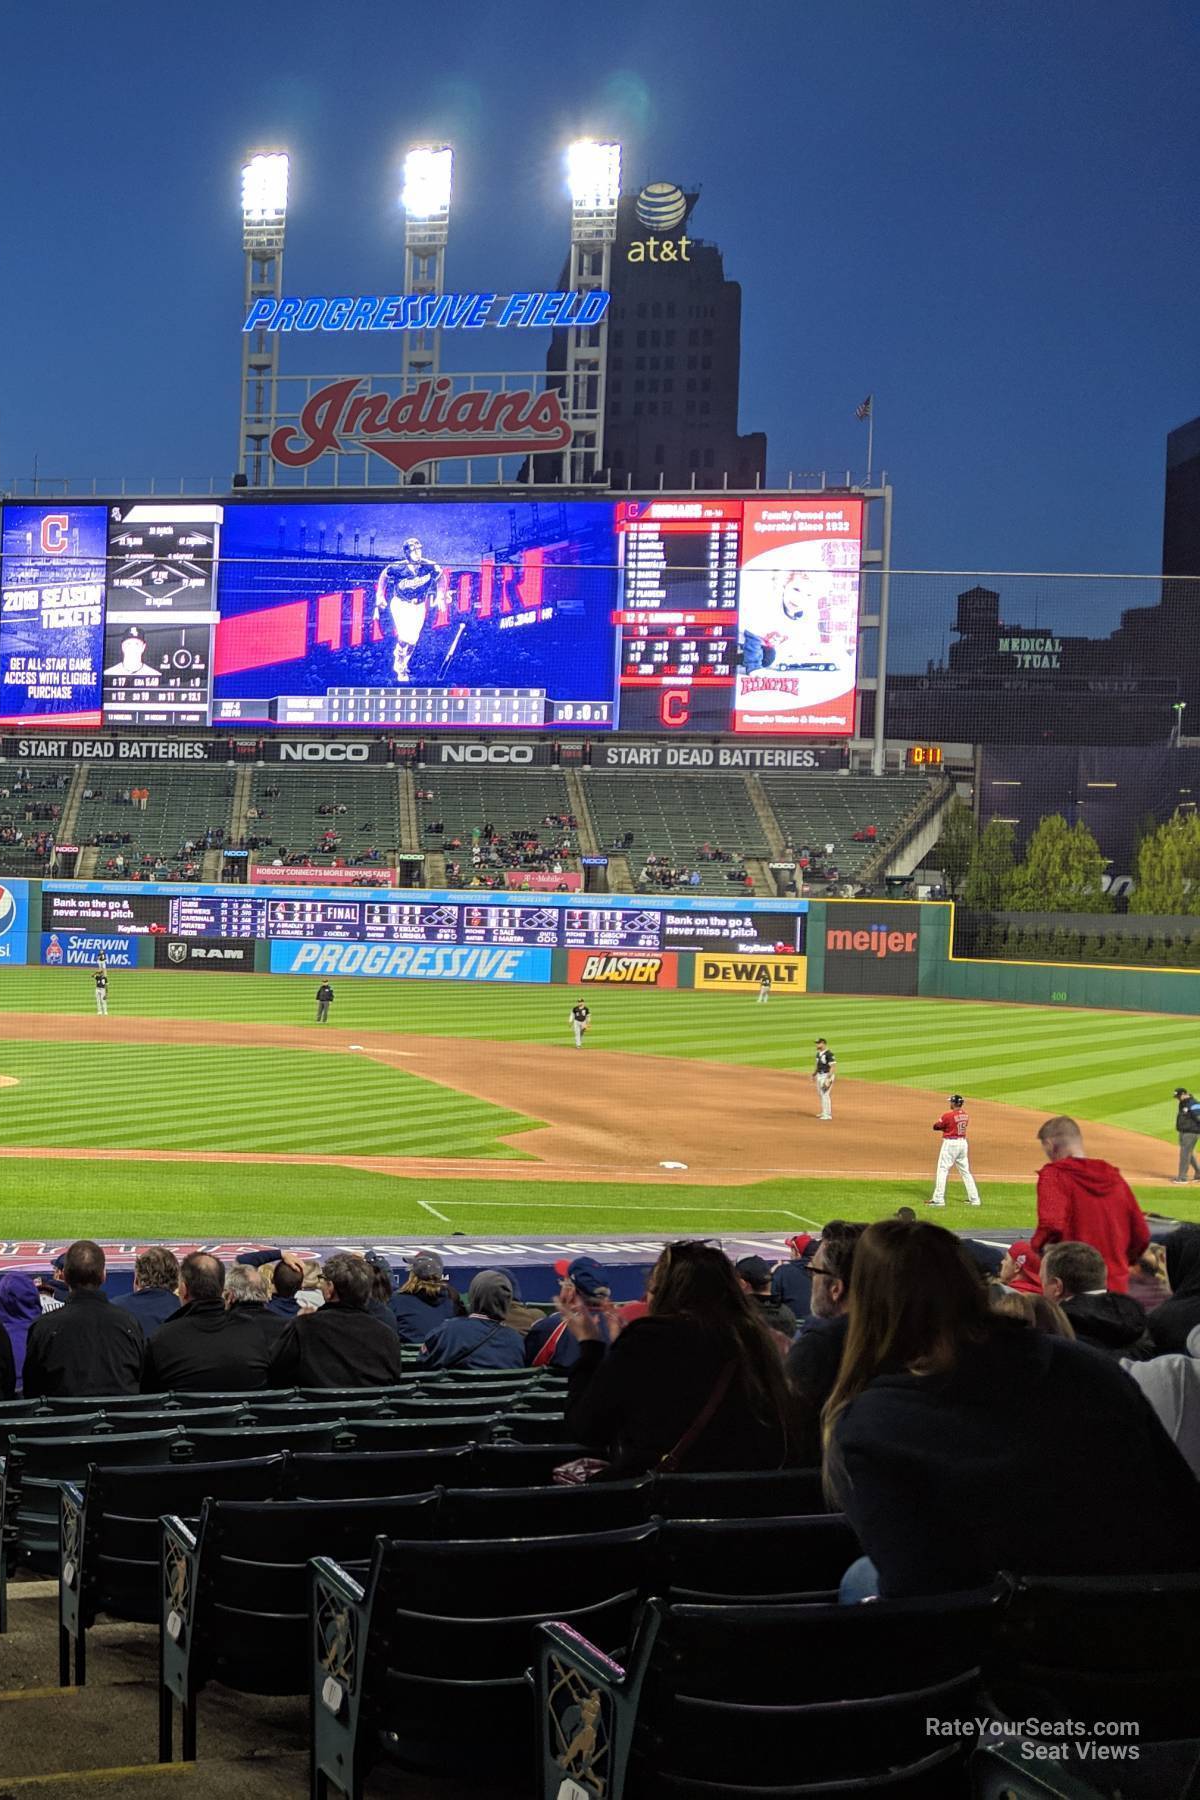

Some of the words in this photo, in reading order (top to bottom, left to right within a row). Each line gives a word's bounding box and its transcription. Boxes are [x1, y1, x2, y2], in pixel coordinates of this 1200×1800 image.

[627, 235, 691, 262] at&t
[242, 293, 498, 333] PROGRESSIVE
[499, 290, 611, 328] FIELD
[269, 377, 573, 473] Indians
[41, 514, 68, 553] C
[41, 584, 101, 608] SEASON
[40, 605, 101, 629] TICKETS
[999, 638, 1063, 652] MEDICAL
[10, 657, 26, 671] GET
[27, 657, 67, 671] ALL-STAR
[69, 657, 92, 671] GAME
[4, 671, 37, 684] ACCESS
[39, 672, 60, 685] WITH
[61, 672, 97, 685] ELIGIBLE
[27, 686, 72, 699] PURCHASE
[741, 677, 799, 696] RUMPKE
[663, 691, 689, 725] C
[18, 740, 68, 757] START
[72, 741, 115, 758] DEAD
[119, 743, 208, 759] BATTERIES.
[280, 743, 370, 761] NOCO
[441, 745, 533, 763] NOCO
[913, 747, 942, 764] 0:11
[607, 747, 661, 764] START
[666, 748, 714, 766] DEAD
[719, 750, 819, 767] BATTERIES.
[582, 857, 608, 865] NOCO
[256, 867, 286, 876] NOBODY
[287, 868, 323, 877] CONNECTS
[324, 869, 344, 877] MORE
[372, 870, 391, 878] FANS
[53, 898, 76, 907] Bank
[91, 899, 107, 908] the
[108, 901, 121, 909] go
[122, 900, 129, 908] &
[80, 909, 100, 917] miss
[111, 909, 134, 919] pitch
[294, 914, 300, 922] 2
[327, 907, 356, 920] FINAL
[403, 916, 409, 924] 2
[616, 922, 622, 930] 2
[666, 915, 693, 925] Bank
[695, 918, 708, 926] on
[710, 916, 726, 926] the
[728, 919, 742, 928] go
[744, 917, 753, 926] &
[118, 925, 150, 933] KeyBank
[696, 927, 720, 936] miss
[731, 928, 757, 938] pitch
[68, 936, 129, 951] SHERWIN
[827, 924, 918, 958] meijer
[191, 948, 244, 959] RAM
[738, 944, 775, 953] KeyBank
[290, 943, 524, 979] PROGRESSIVE
[1050, 991, 1067, 1001] 400
